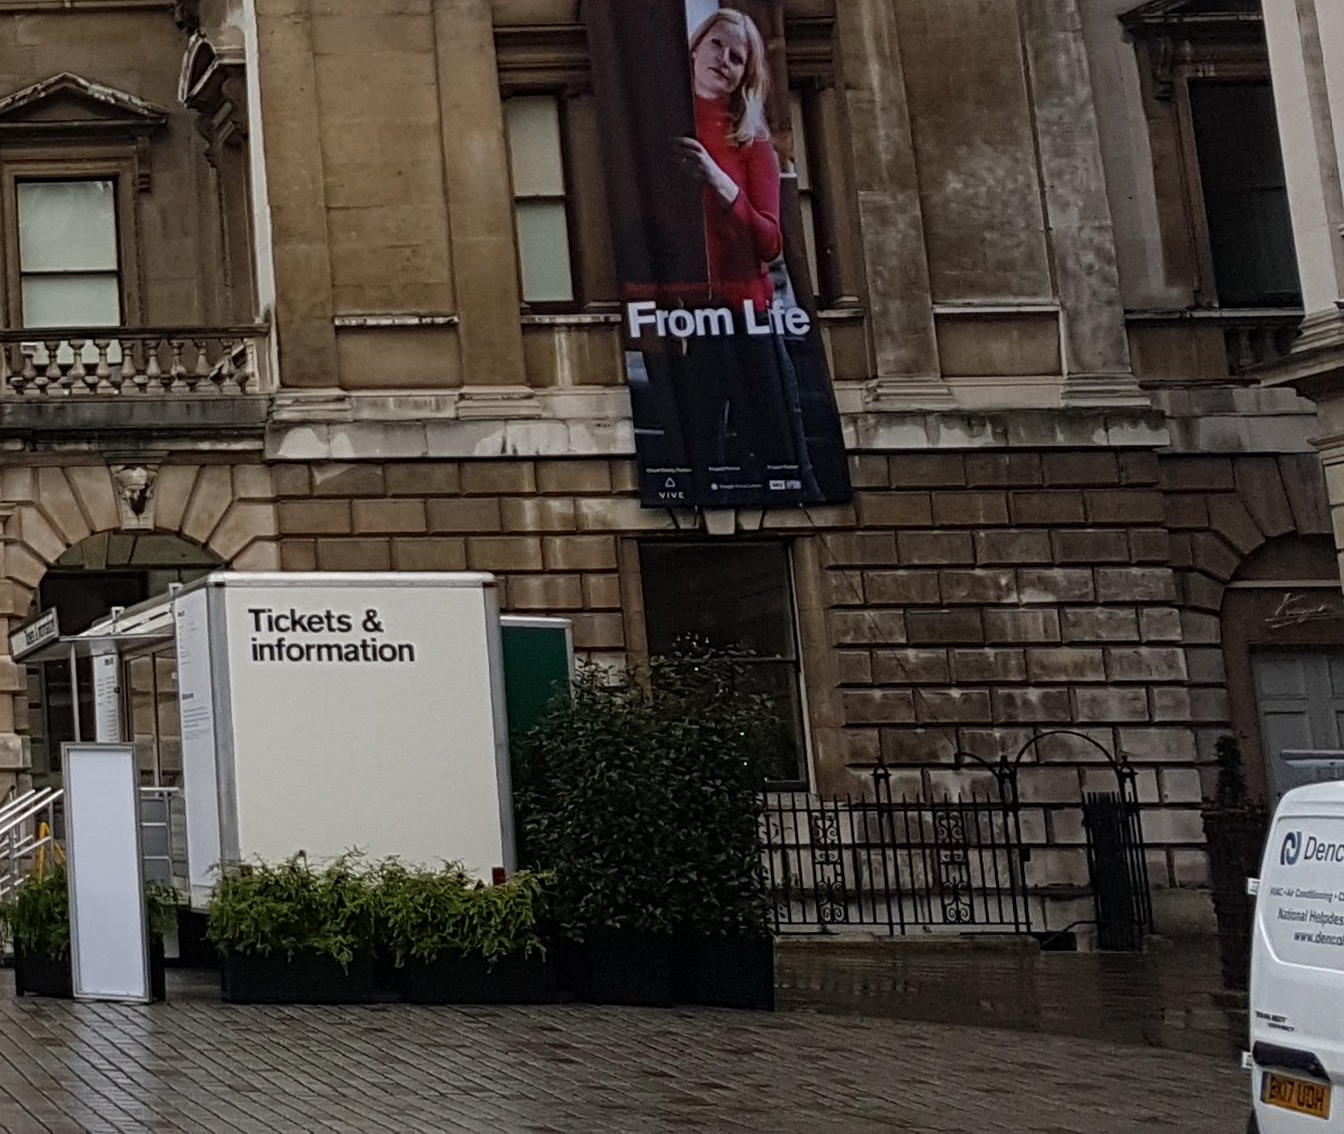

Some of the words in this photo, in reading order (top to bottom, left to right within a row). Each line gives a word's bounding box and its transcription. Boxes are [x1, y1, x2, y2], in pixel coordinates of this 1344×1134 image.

[626, 300, 735, 339] From
[743, 298, 811, 337] Life
[248, 608, 353, 633] Tickets
[362, 608, 385, 633] &
[251, 637, 416, 662] information
[1277, 906, 1308, 922] National
